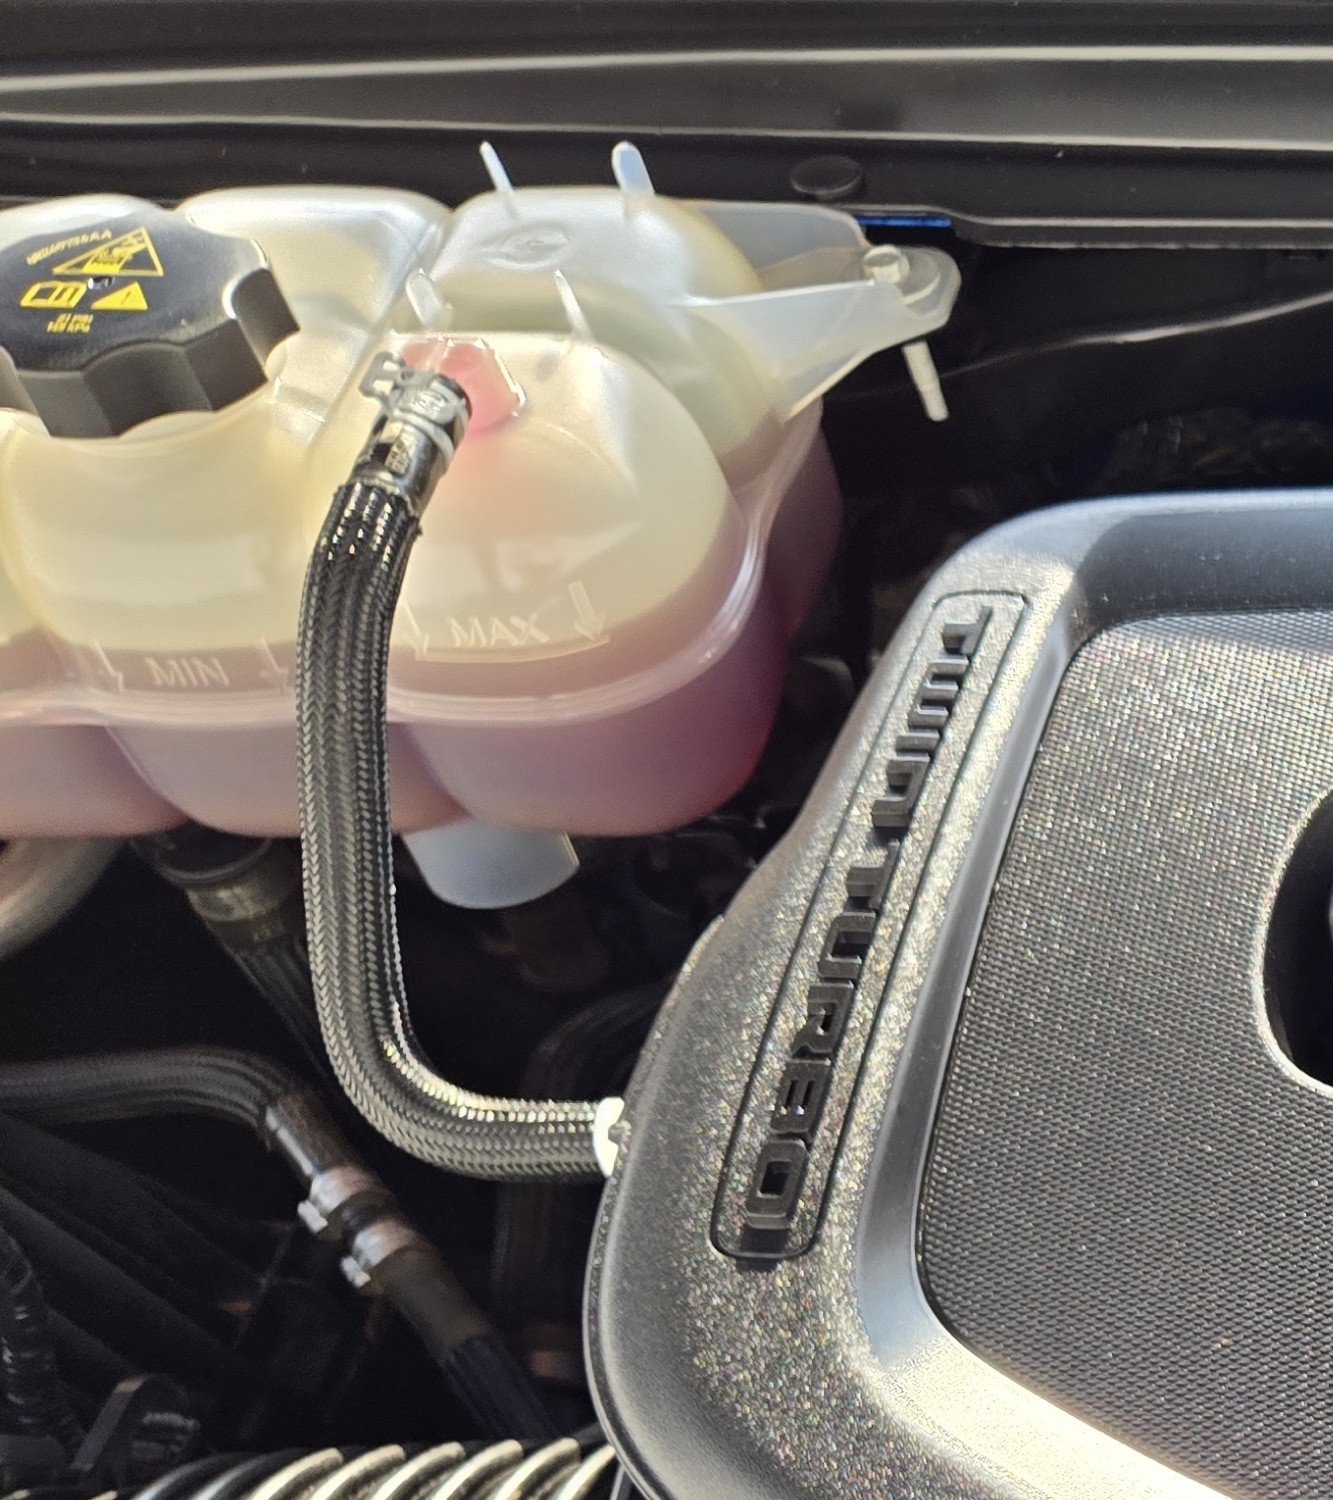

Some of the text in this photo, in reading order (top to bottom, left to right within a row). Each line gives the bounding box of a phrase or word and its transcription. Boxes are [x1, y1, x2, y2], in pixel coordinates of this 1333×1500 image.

[447, 612, 551, 648] MAX
[143, 656, 231, 688] MIN
[746, 840, 901, 1230] TURBO
